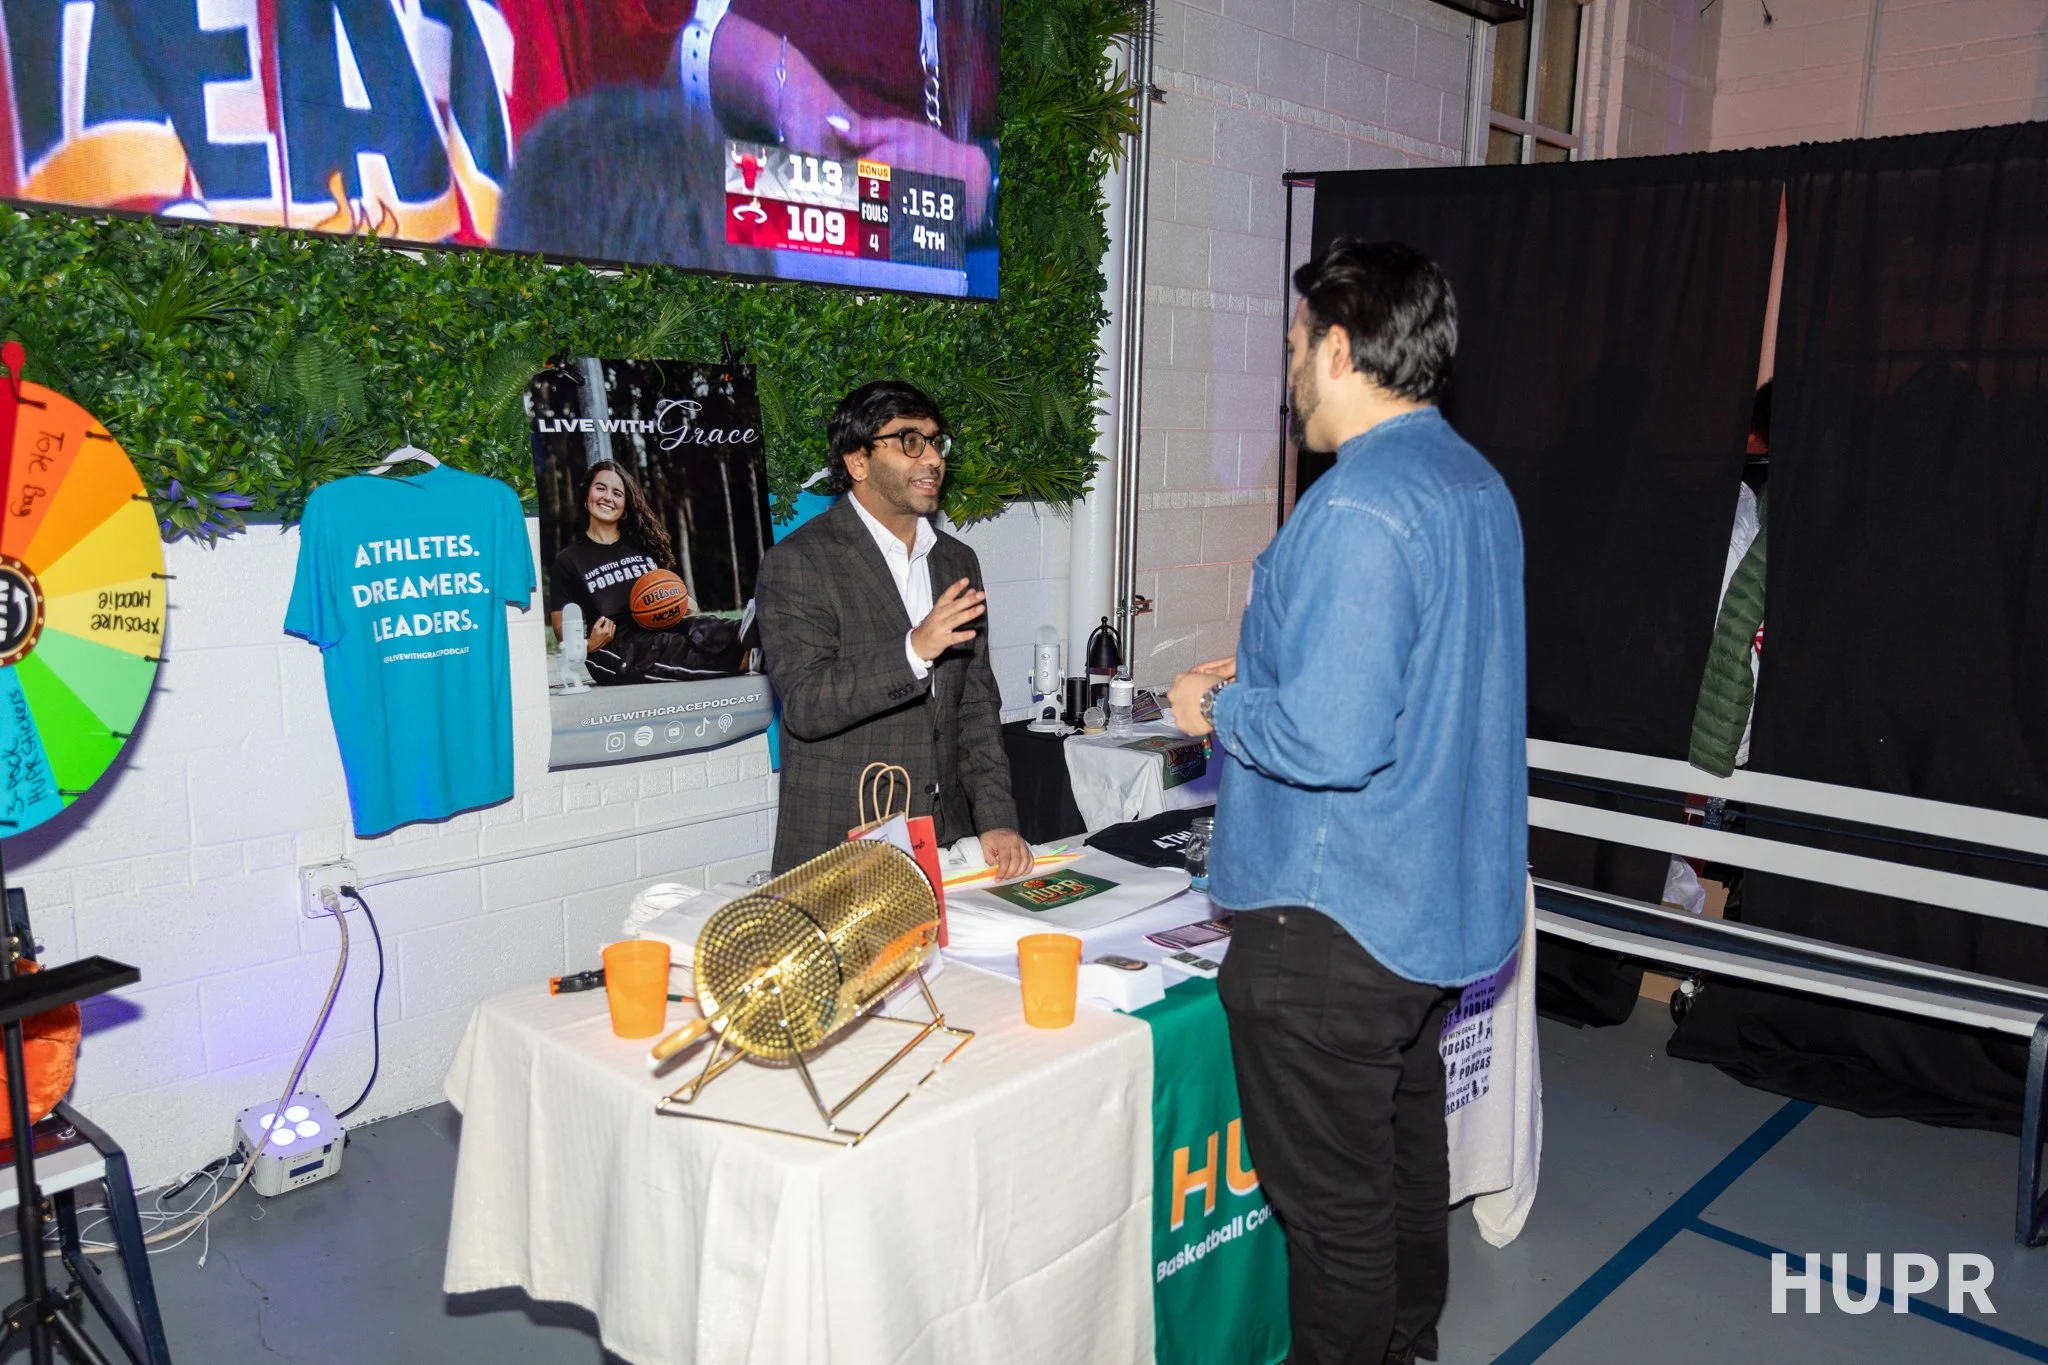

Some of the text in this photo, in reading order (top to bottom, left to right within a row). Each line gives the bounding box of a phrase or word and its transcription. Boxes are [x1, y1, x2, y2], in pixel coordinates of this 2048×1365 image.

[789, 154, 843, 195] 113
[859, 164, 890, 179] BONUS
[869, 179, 880, 198] 2
[902, 187, 954, 222] :15.8
[787, 204, 846, 246] 109
[861, 202, 889, 223] FOULS
[869, 233, 880, 253] 4
[912, 224, 946, 252] 4TH
[538, 399, 760, 451] LIVE WITH Grace
[353, 535, 481, 569] ATHLETES.
[584, 555, 645, 581] LIVE WITH GRACE
[351, 572, 491, 609] DREAMERS.
[587, 563, 650, 594] PODCAST
[641, 586, 681, 607] Wilson
[373, 609, 479, 644] LEADERS.
[650, 605, 681, 622] NCAA
[581, 693, 762, 727] @LIVEWITHGRACEPODCAST
[1157, 1215, 1244, 1284] Basketball
